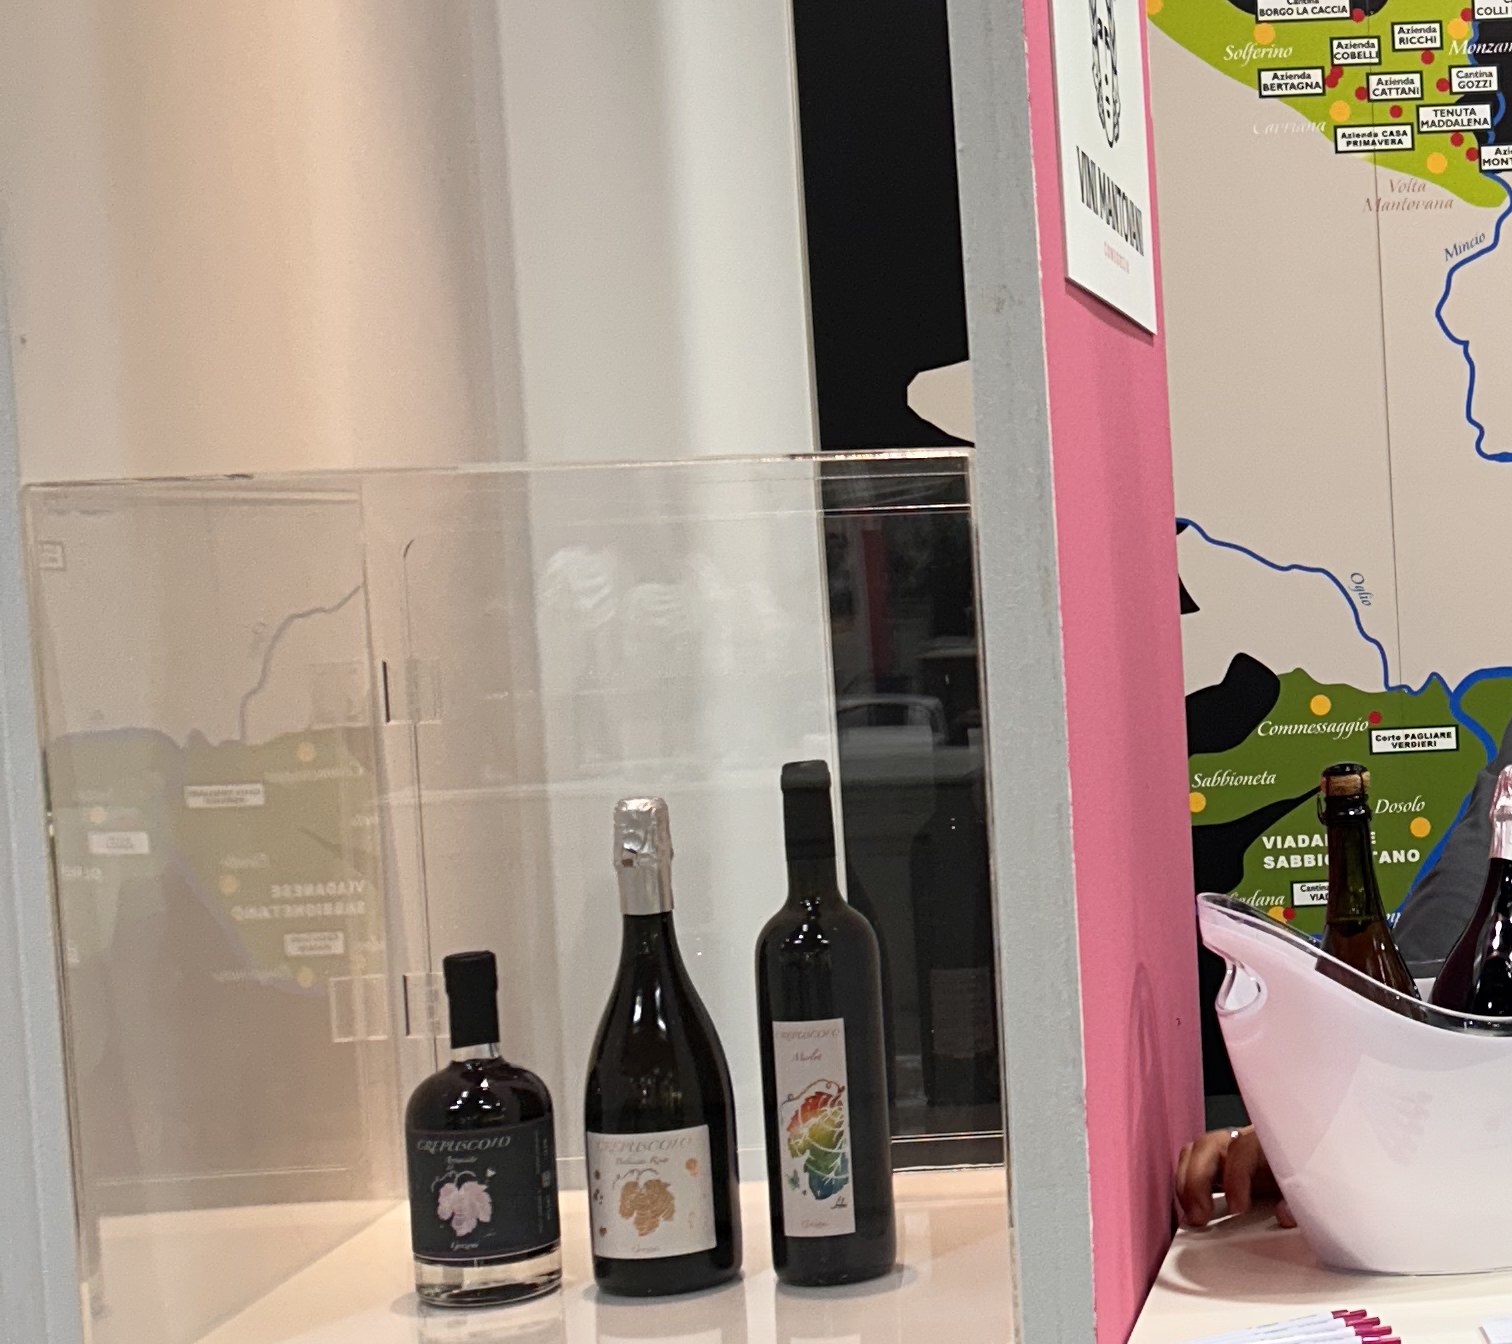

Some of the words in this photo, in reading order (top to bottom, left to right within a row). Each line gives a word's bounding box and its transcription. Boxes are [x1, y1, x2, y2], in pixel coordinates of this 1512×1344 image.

[1259, 6, 1294, 17] BORGO
[1297, 6, 1308, 16] LA
[1311, 5, 1348, 15] CACCIA
[1476, 5, 1509, 16] COLLI
[1397, 24, 1438, 35] Azienda
[1336, 40, 1376, 50] Azienda
[1398, 35, 1438, 46] RICCHI
[1223, 42, 1293, 67] Solferino
[1334, 50, 1380, 61] COBELLI
[1271, 71, 1312, 82] Azienda
[1456, 69, 1494, 79] Cantina
[1262, 81, 1322, 93] BERTAGNA
[1376, 77, 1416, 87] Azienda
[1457, 79, 1492, 90] GOZZI
[1372, 86, 1421, 97] CATTANI
[1432, 107, 1477, 118] TENUTA
[1420, 117, 1490, 129] MADDALENA
[1340, 130, 1380, 140] Azienda
[1381, 129, 1408, 138] CASA
[1346, 137, 1404, 147] PRIMAVERA
[1388, 177, 1427, 194] Volta
[1362, 195, 1454, 214] Mantovana
[1444, 231, 1487, 262] Mincio
[1349, 572, 1372, 608] Oglio
[1257, 717, 1370, 742] Commessaggio
[1403, 730, 1453, 741] PAGLIARE
[1192, 771, 1277, 789] Sabbioneta
[1375, 794, 1426, 815] Dosolo
